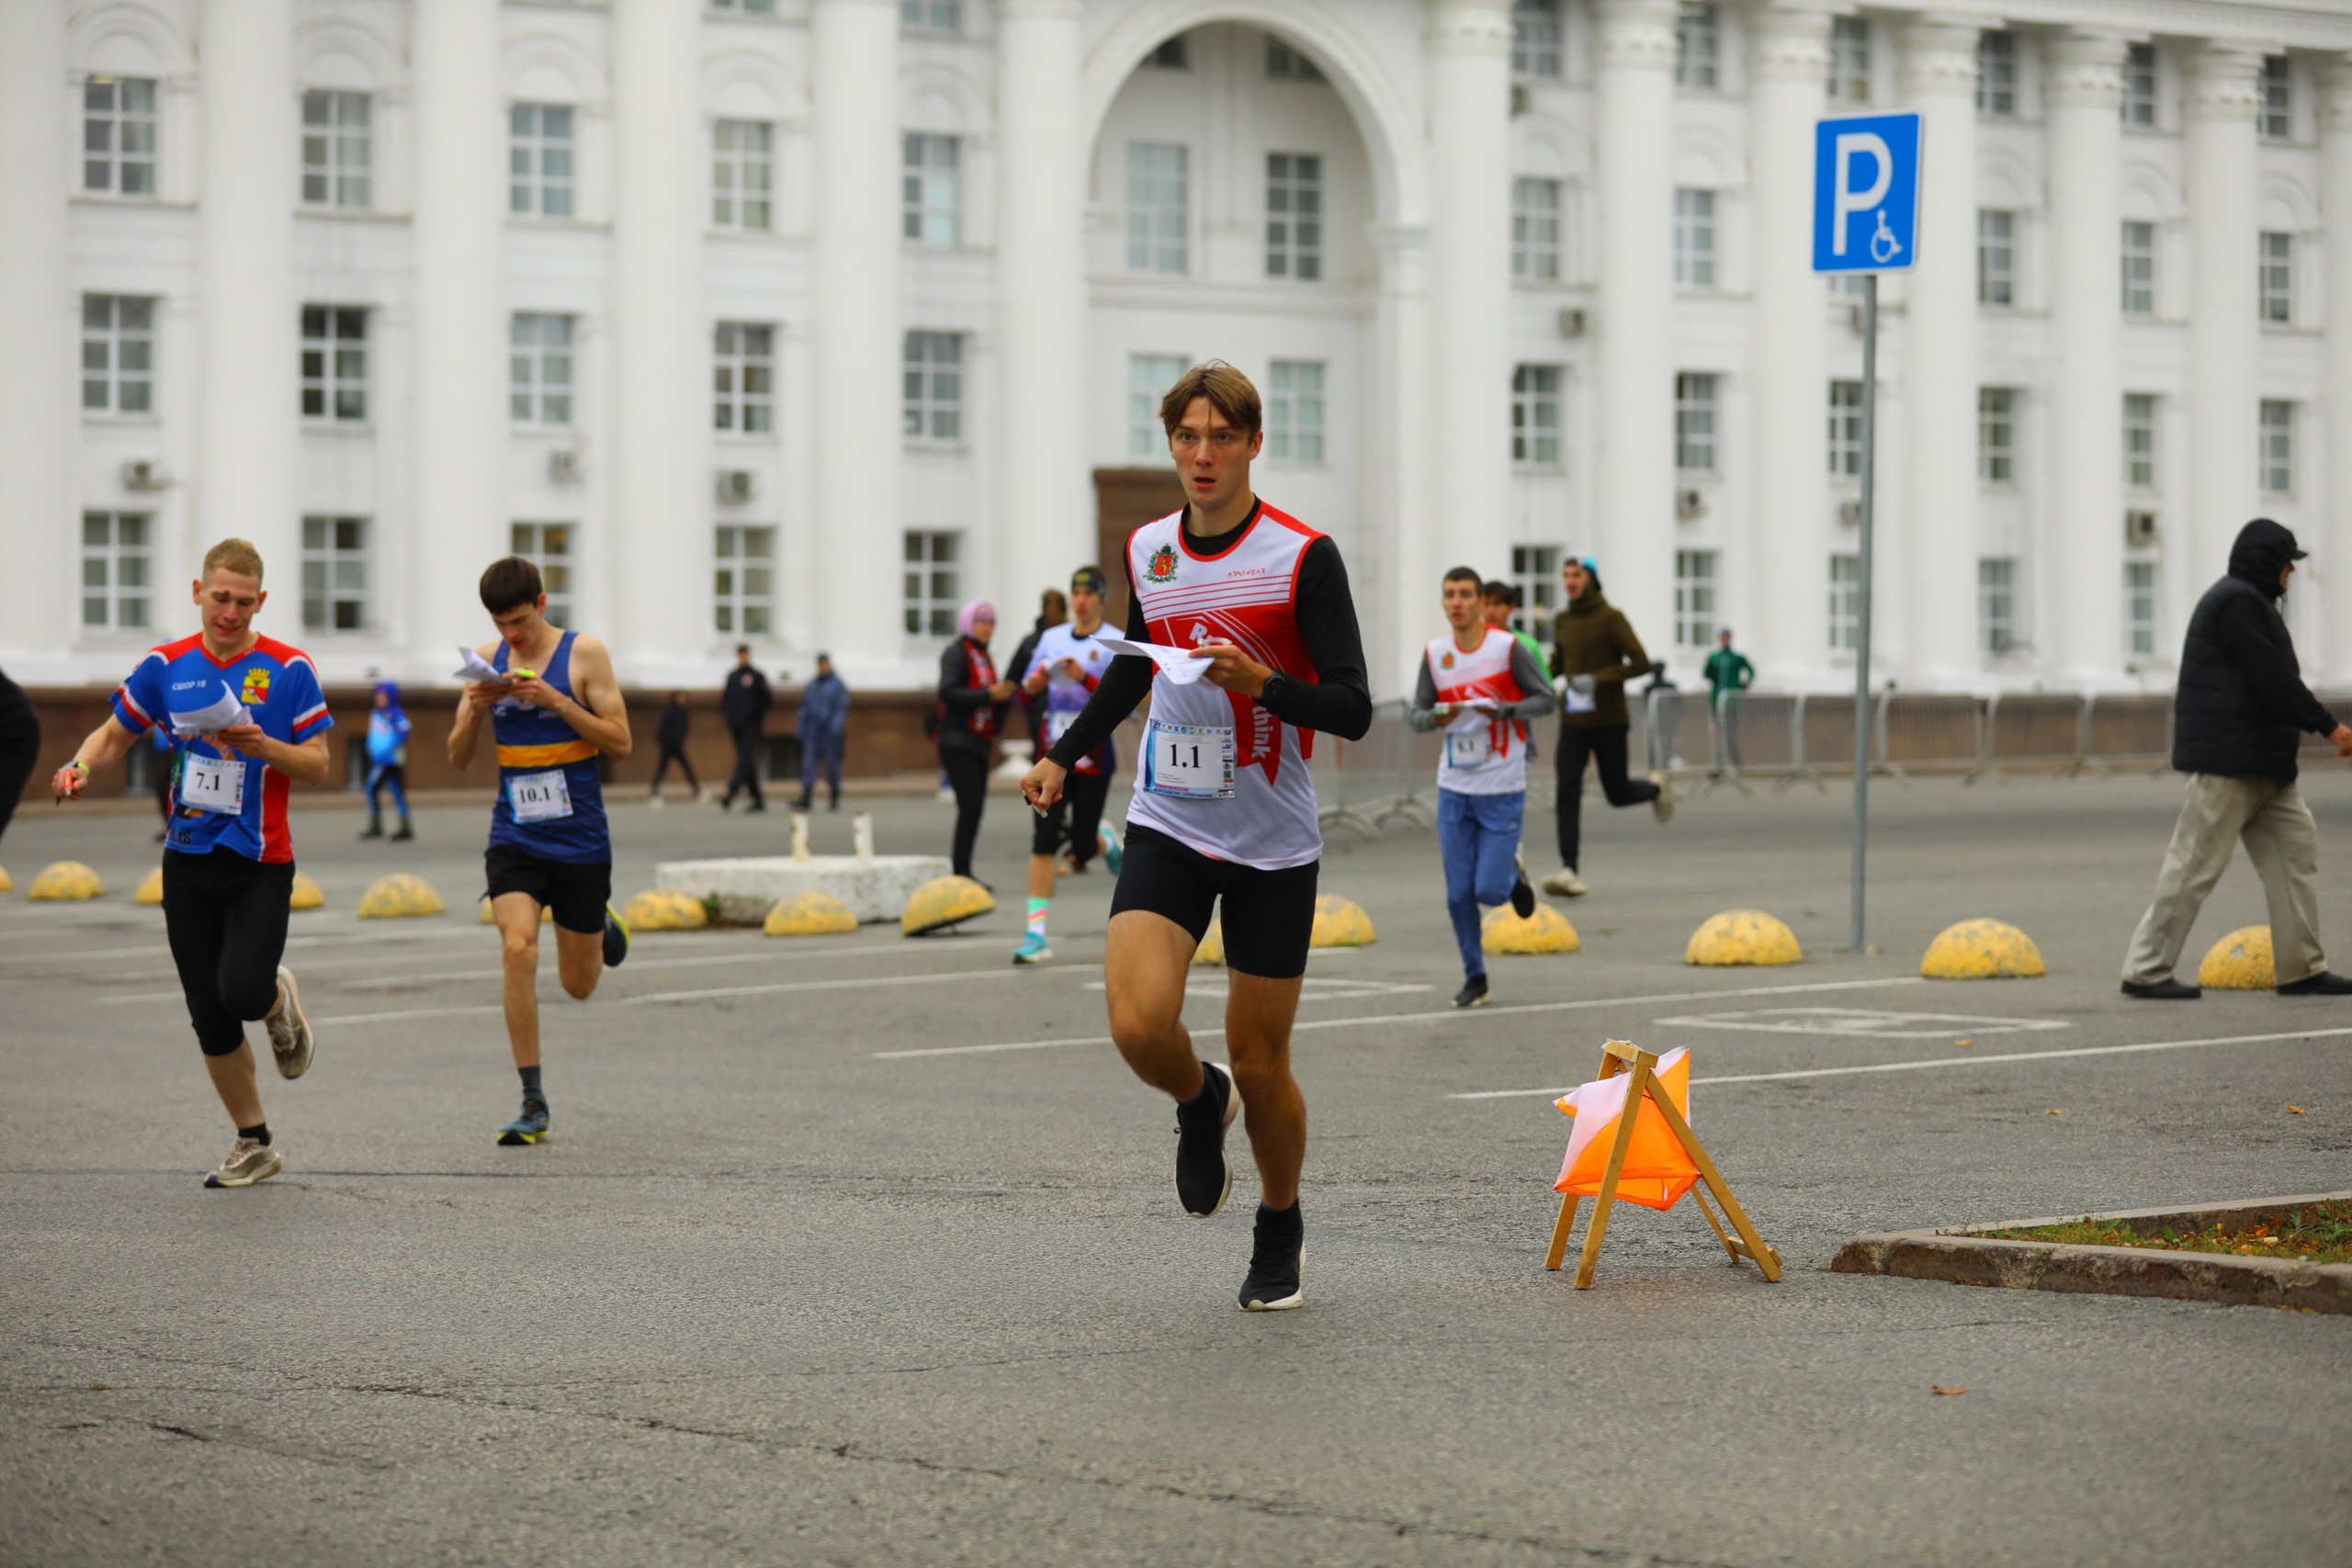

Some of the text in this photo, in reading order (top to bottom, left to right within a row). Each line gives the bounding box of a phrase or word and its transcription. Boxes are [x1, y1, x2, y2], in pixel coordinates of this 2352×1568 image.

[1832, 131, 1894, 257] P
[197, 679, 207, 688] 18
[1170, 743, 1202, 769] 1.1
[196, 772, 221, 791] 7.1
[519, 785, 551, 804] 10.1
